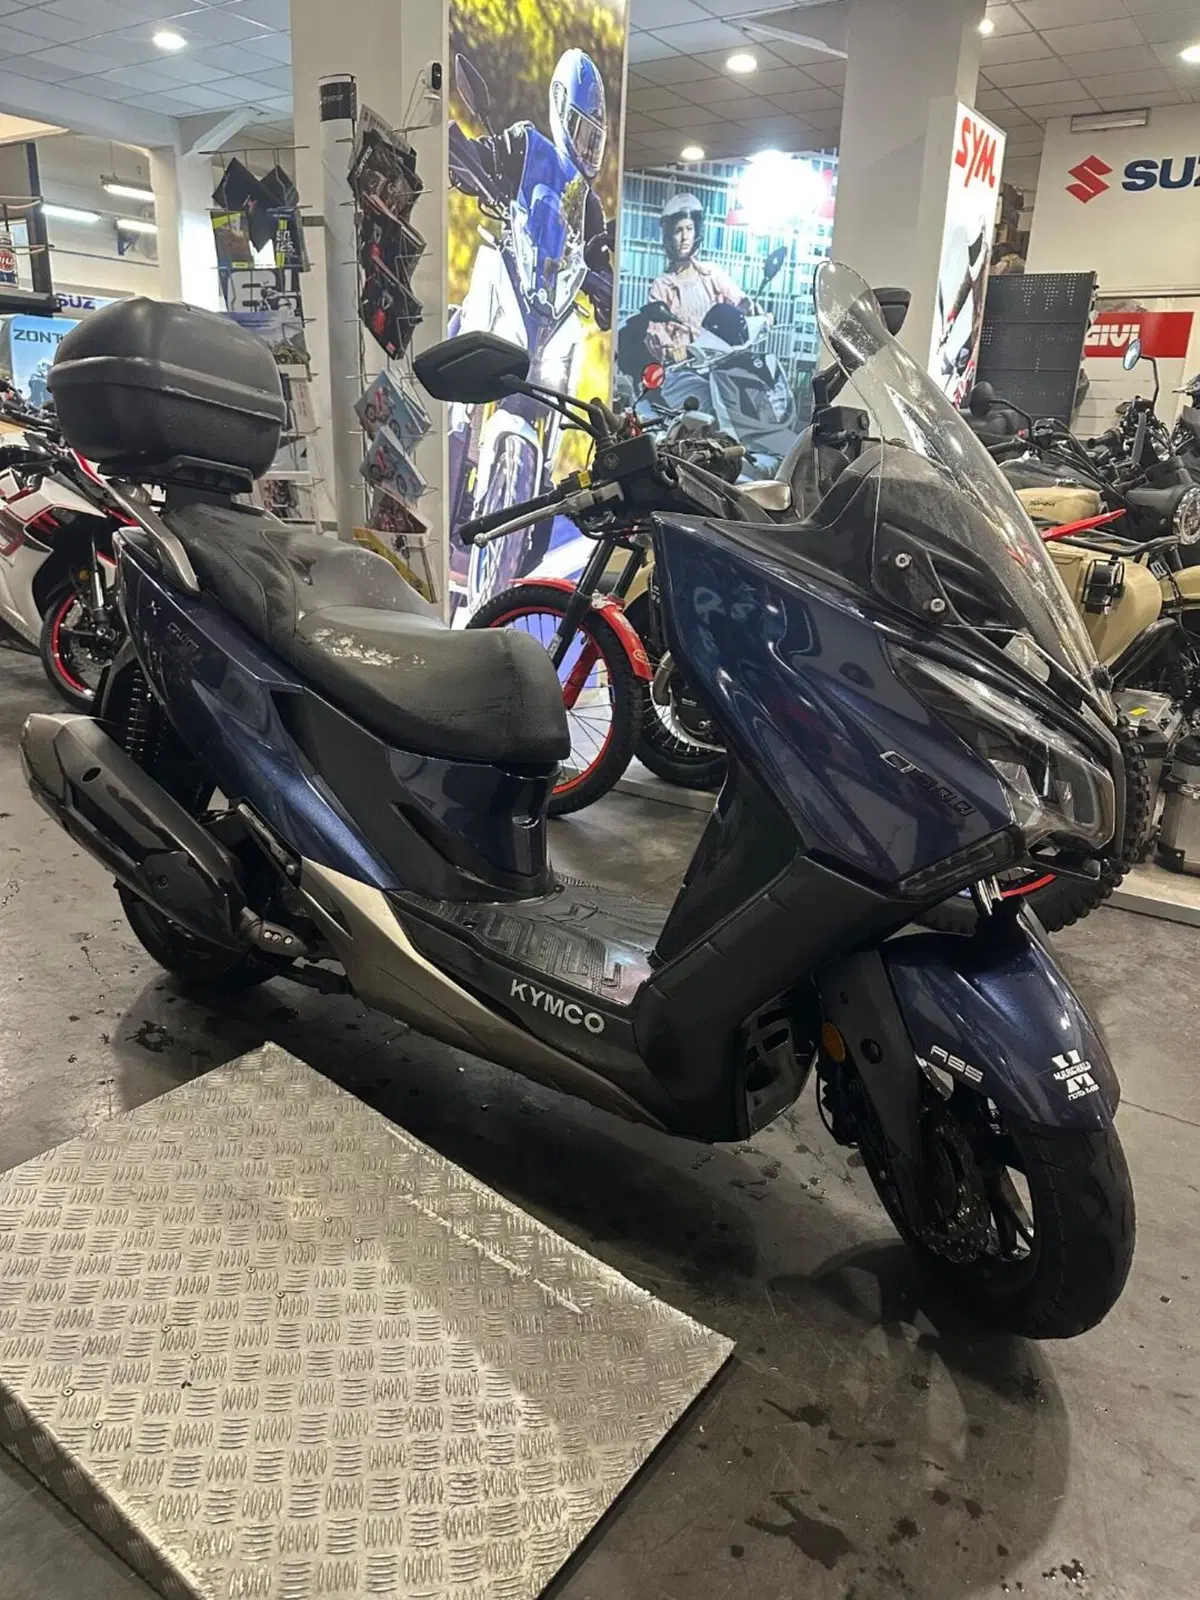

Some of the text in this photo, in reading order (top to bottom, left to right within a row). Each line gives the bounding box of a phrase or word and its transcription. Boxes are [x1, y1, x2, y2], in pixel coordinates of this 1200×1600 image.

[955, 116, 997, 189] SYM
[1083, 324, 1141, 347] GIVI
[509, 978, 605, 1034] KYMCO
[930, 1044, 984, 1084] ABS
